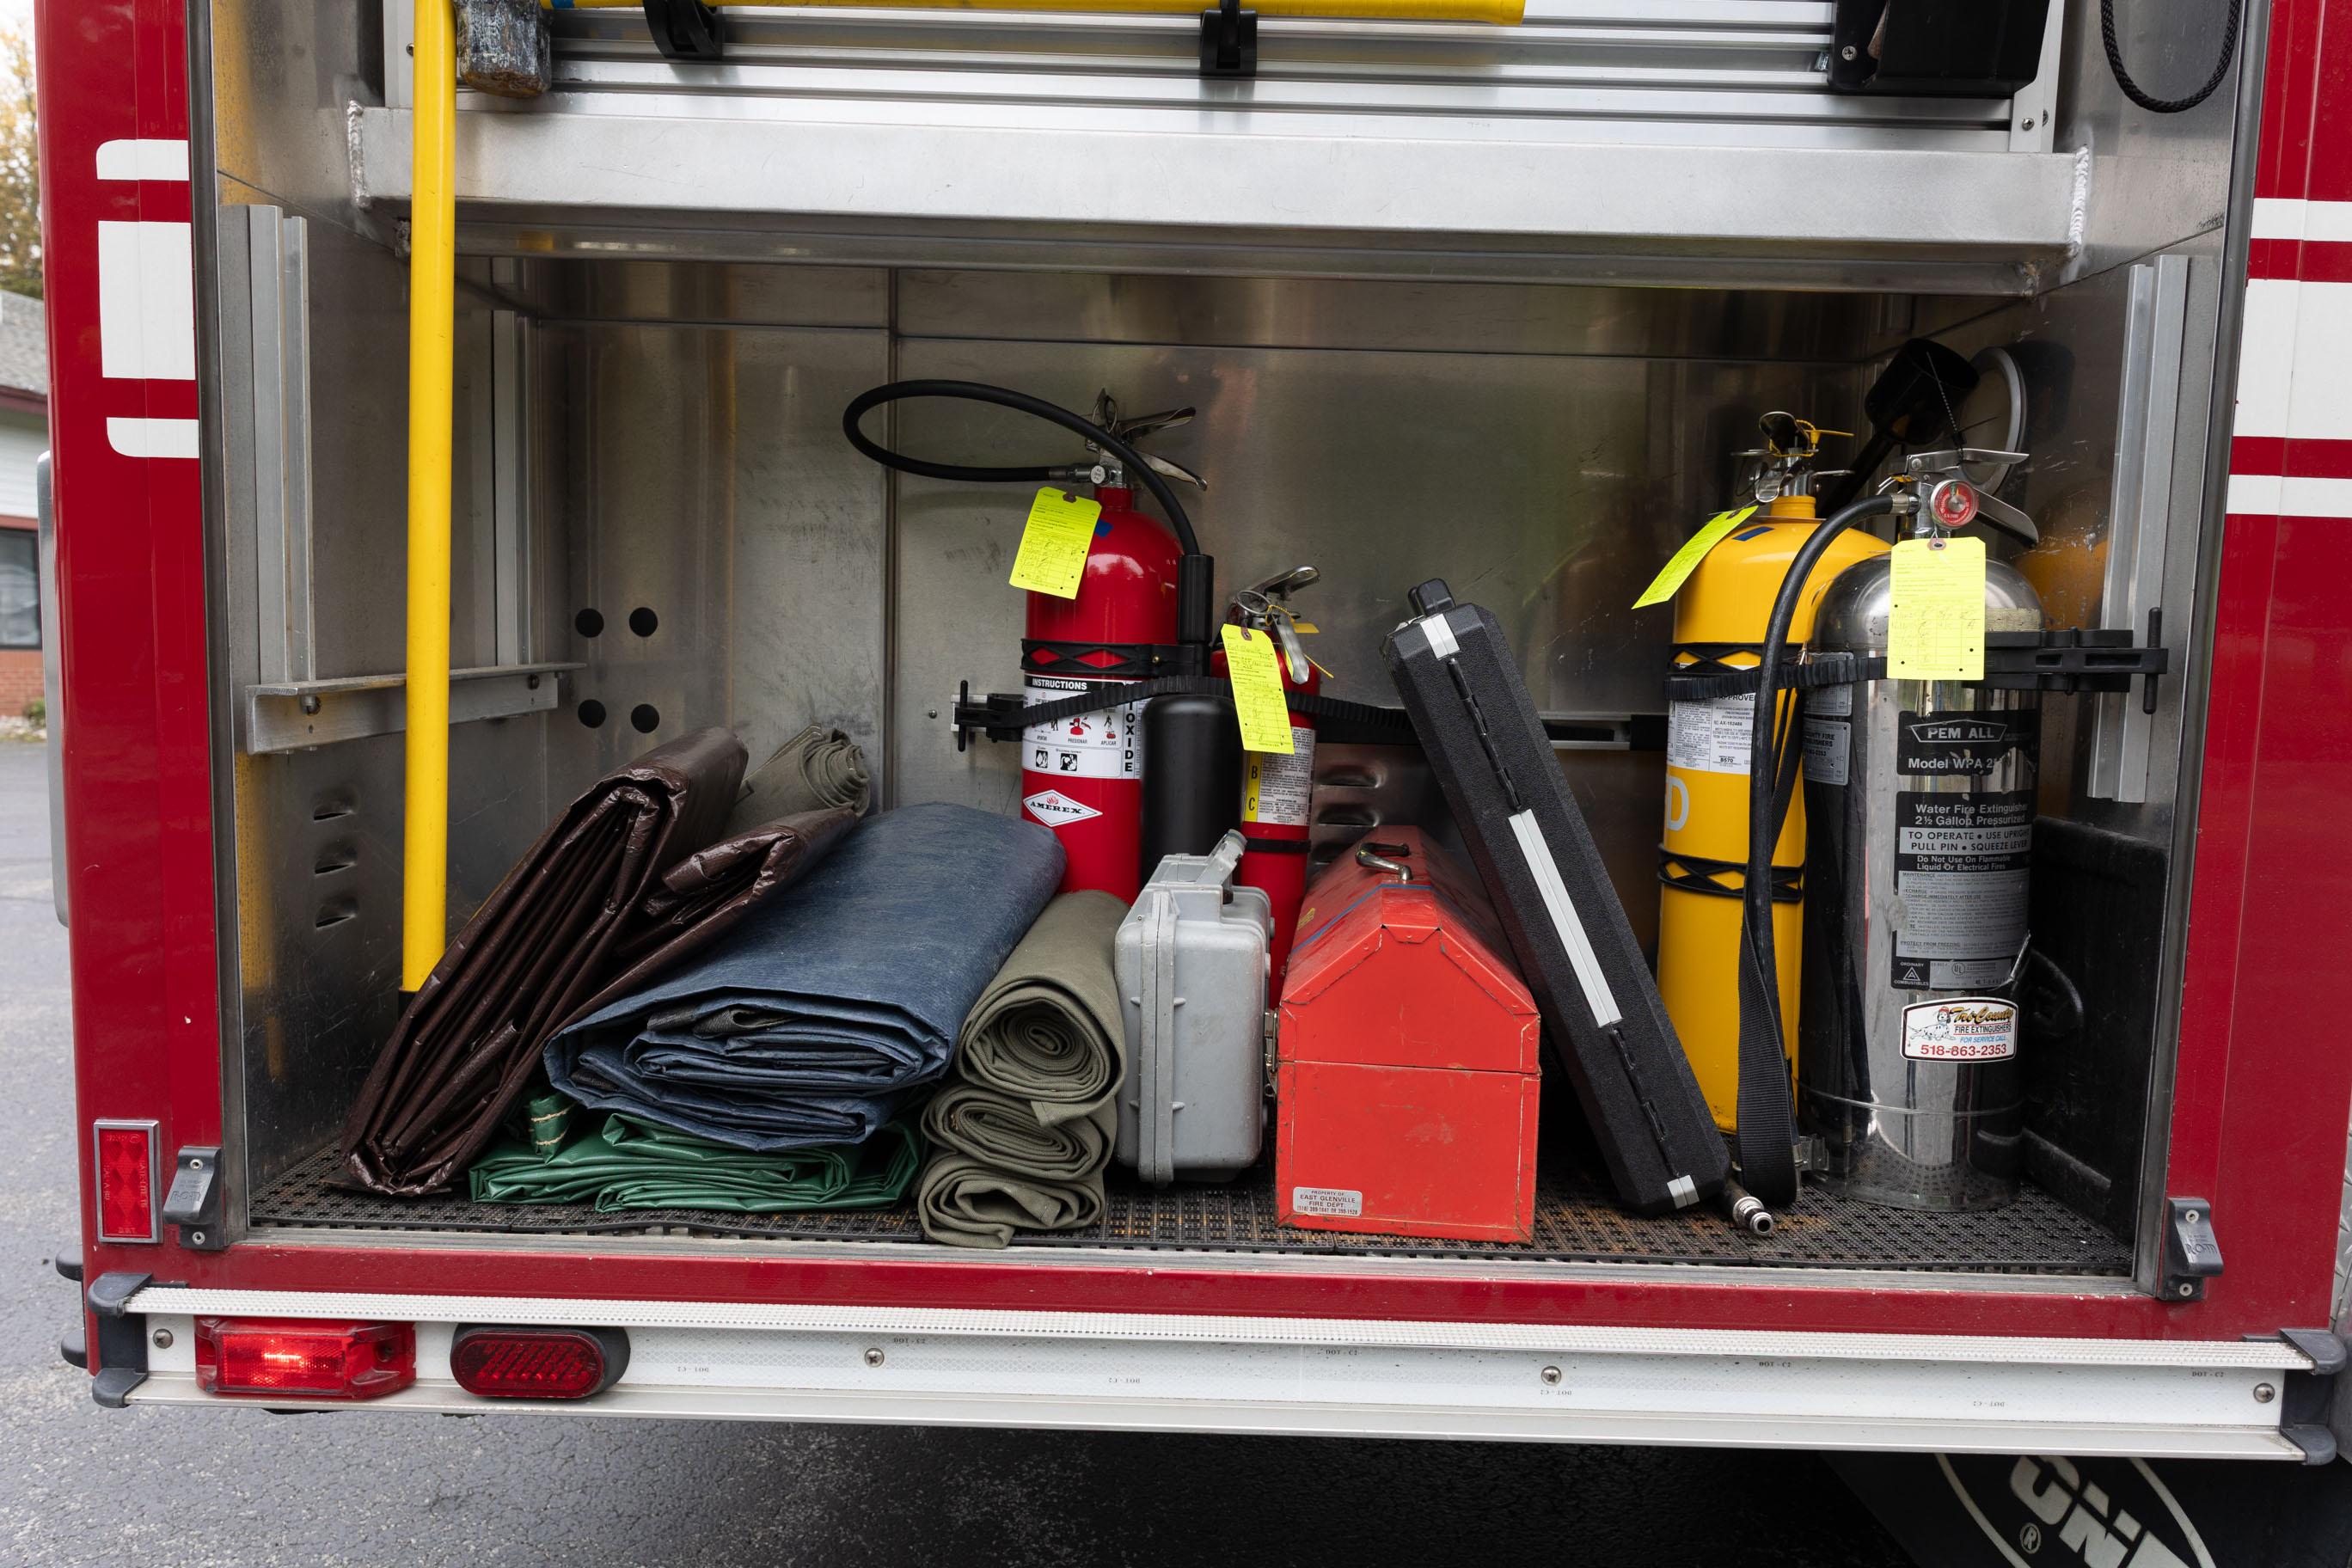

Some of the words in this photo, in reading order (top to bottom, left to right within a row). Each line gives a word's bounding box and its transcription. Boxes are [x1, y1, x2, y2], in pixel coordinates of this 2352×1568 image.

[1032, 678, 1087, 690] INSTRUCTIONS
[1124, 701, 1136, 772] IOXIDE
[1927, 727, 1961, 739] PEM
[1968, 727, 1994, 738] ALL
[1908, 757, 1949, 769] Model
[1953, 758, 1983, 769] WPA
[1251, 765, 1258, 780] B
[1030, 801, 1082, 814] AMEREX
[1248, 797, 1255, 811] C
[1915, 804, 1951, 813] Water
[1954, 804, 1975, 814] Fire
[1979, 804, 2028, 814] Extinguisher
[1914, 816, 1933, 825] 2½
[1935, 816, 1973, 826] Gallon
[1976, 815, 2025, 826] Pressurized
[1908, 831, 1922, 840] TO
[1927, 831, 1975, 840] OPERATE
[1986, 831, 2001, 840] USE
[2004, 829, 2029, 839] UPRIGHT
[1911, 842, 1936, 851] PULL
[1940, 842, 1958, 851] PIN
[1970, 842, 2008, 852] SQUEEZE
[2010, 840, 2028, 849] LEVER
[1916, 862, 1942, 872] Liquid
[1955, 1026, 1969, 1034] FIRE
[1970, 1024, 2012, 1034] EXTINGUISHERS
[1920, 1044, 2007, 1057] 518-863-2353
